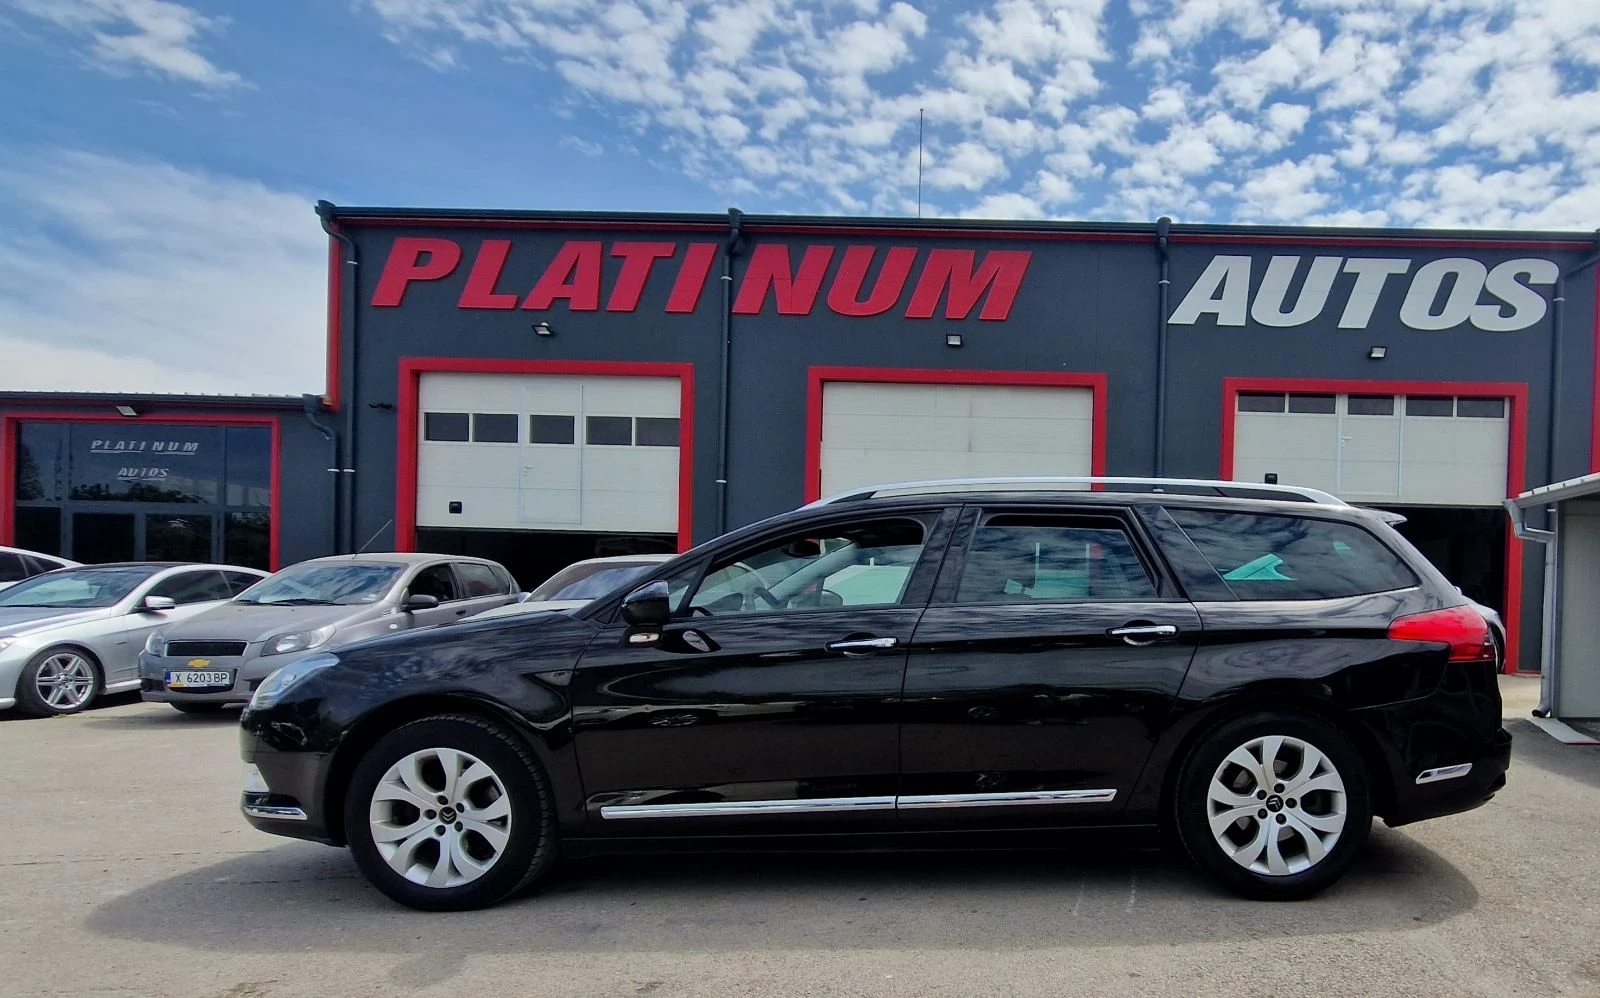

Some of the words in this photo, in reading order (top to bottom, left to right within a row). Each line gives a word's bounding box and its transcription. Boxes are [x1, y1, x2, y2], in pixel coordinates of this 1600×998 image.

[370, 237, 1033, 321] PLATINUM
[1167, 254, 1560, 332] AUTOS
[91, 440, 199, 452] PLATINUM
[117, 467, 169, 477] AUTOS
[175, 673, 182, 683] X
